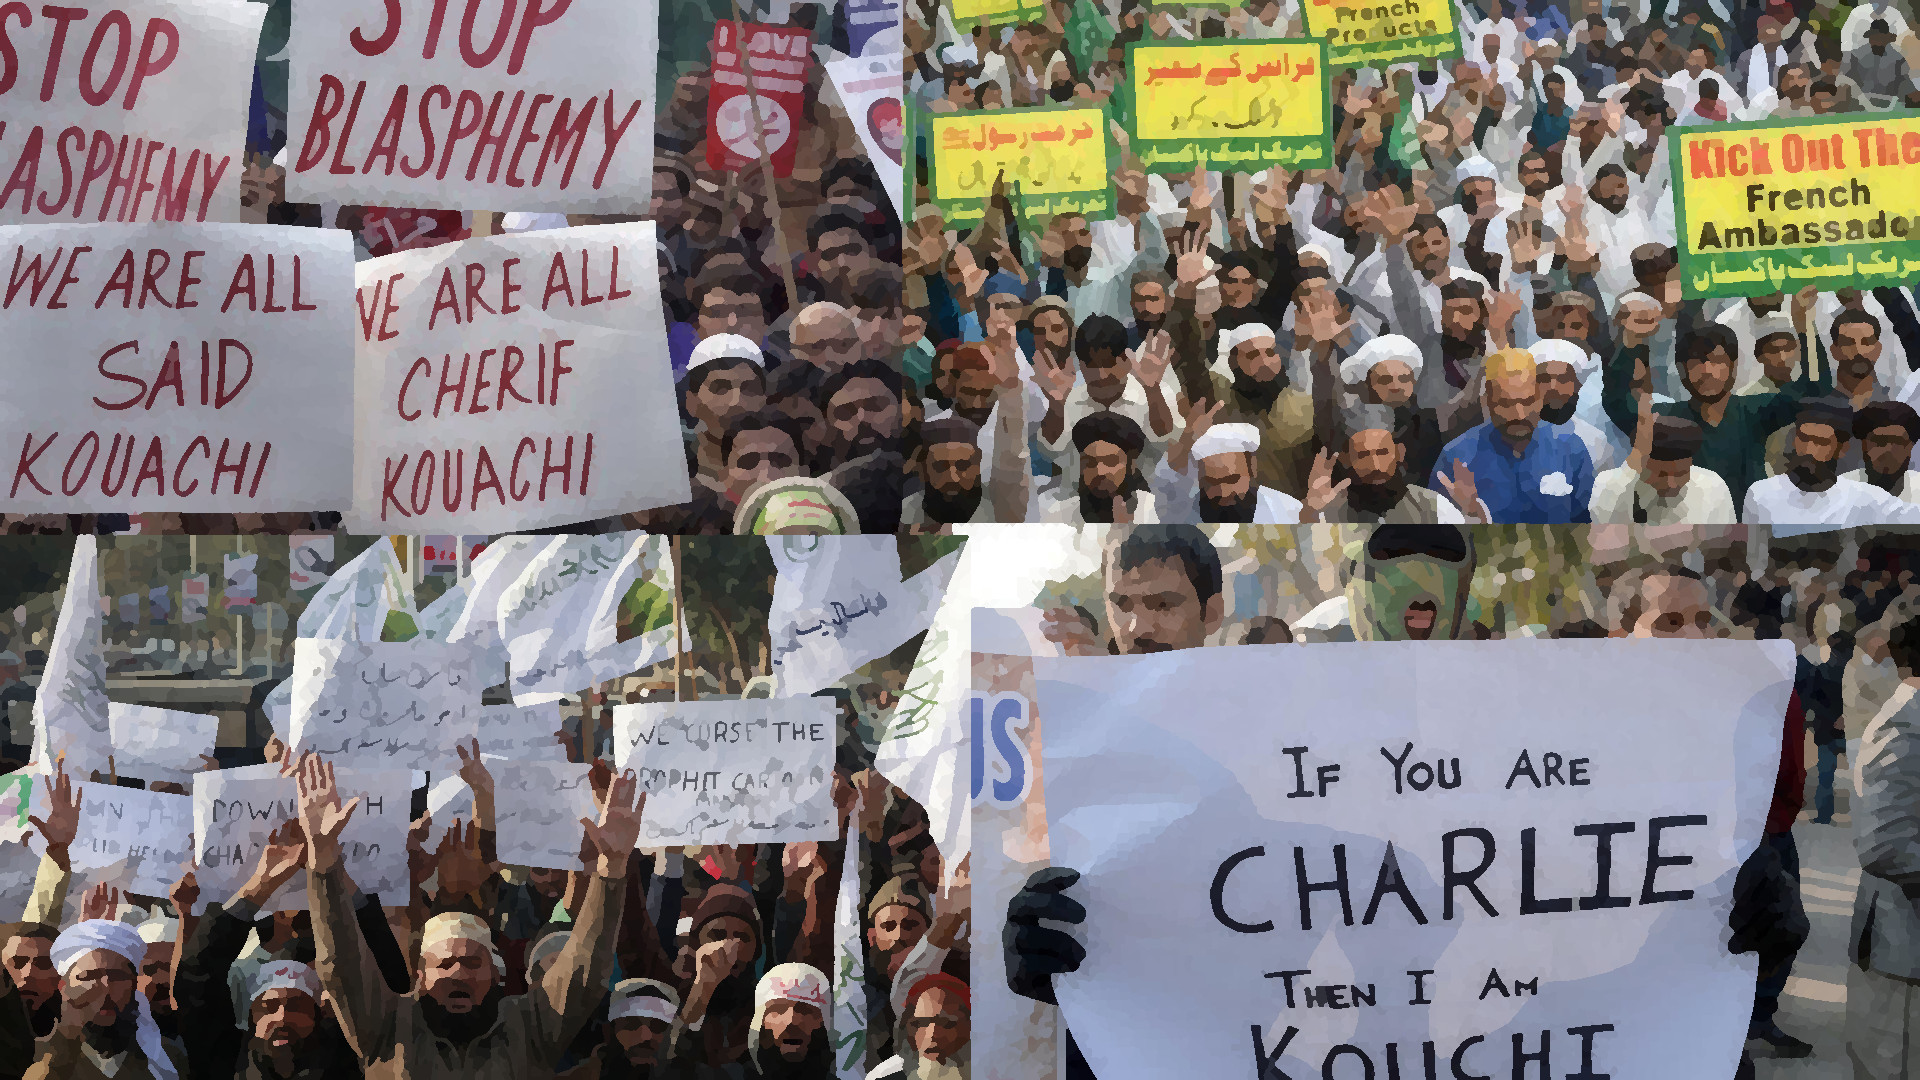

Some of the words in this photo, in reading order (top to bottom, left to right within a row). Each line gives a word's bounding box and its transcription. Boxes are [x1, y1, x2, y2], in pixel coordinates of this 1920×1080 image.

[0, 1, 180, 110] STOP
[295, 74, 642, 190] BLASPHEMY
[1689, 138, 1773, 179] Kick
[1781, 133, 1847, 173] Out
[1746, 177, 1871, 212] French
[3, 245, 92, 309] WE
[94, 249, 206, 309] ARE
[220, 253, 317, 313] ALL
[428, 258, 521, 330] ARE
[542, 246, 632, 311] ALL
[92, 338, 253, 411] SAID
[398, 339, 575, 421] CHERIF
[9, 430, 272, 498] KOUACHI
[381, 432, 593, 521] KOUACHI
[772, 720, 825, 743] THE
[1282, 745, 1341, 798] IF
[1380, 742, 1461, 794] YOU
[1505, 749, 1591, 789] ARE
[1210, 815, 1708, 933] CHARLIE
[1264, 968, 1377, 1010] THEN
[1406, 969, 1435, 1006] I
[1479, 967, 1539, 1000] AM
